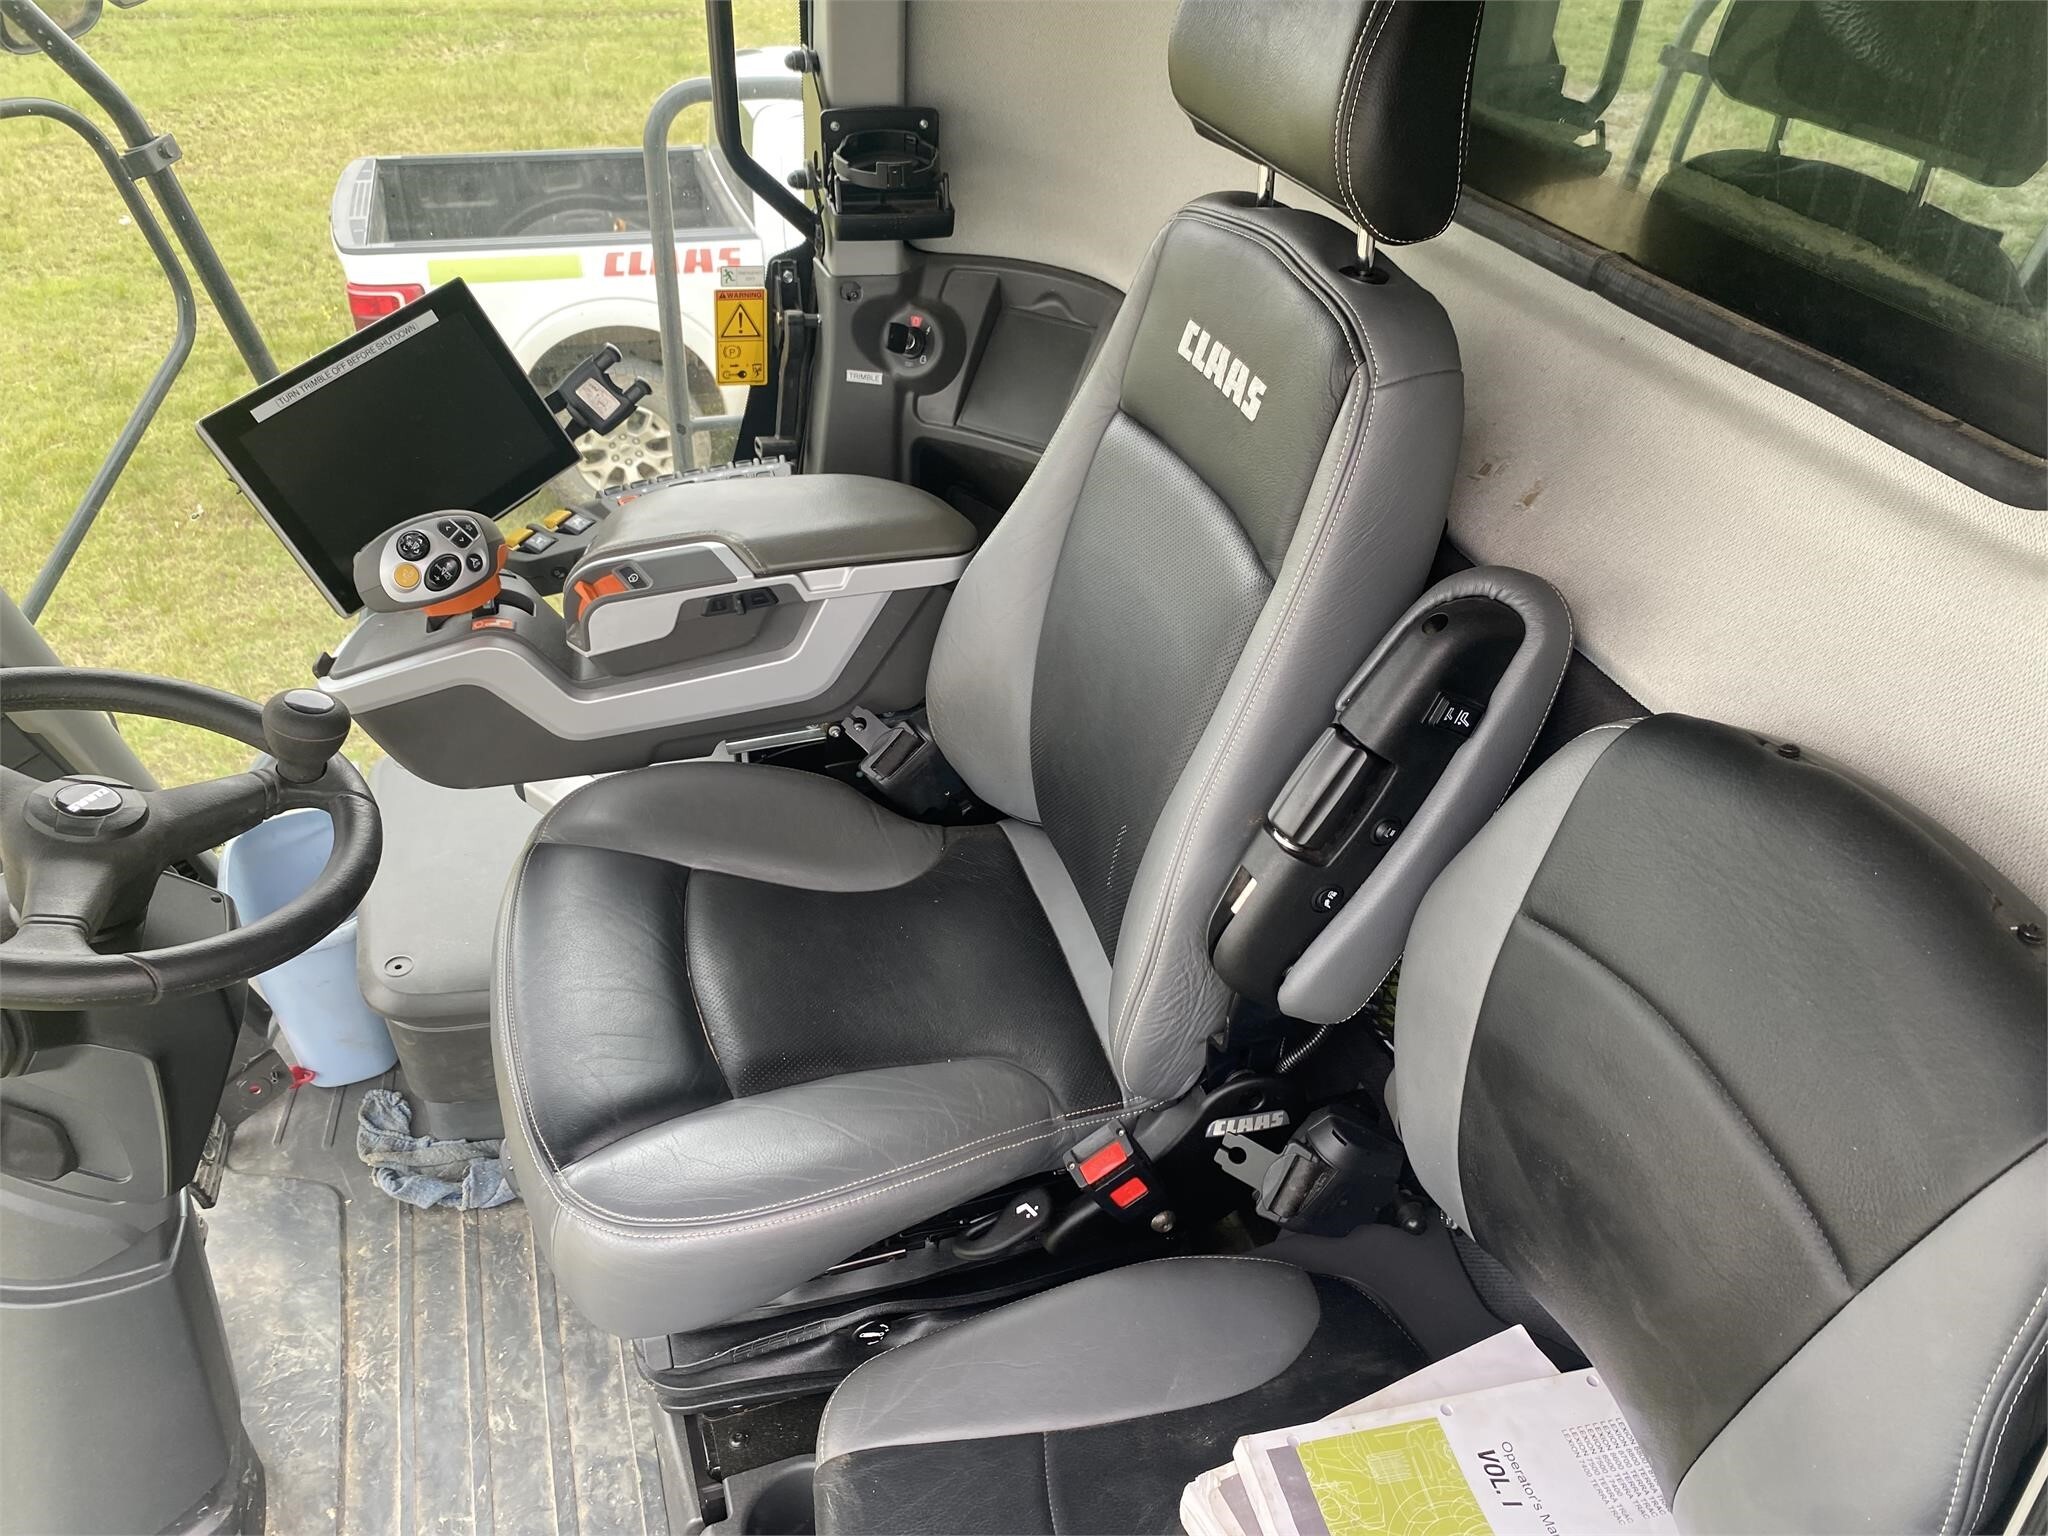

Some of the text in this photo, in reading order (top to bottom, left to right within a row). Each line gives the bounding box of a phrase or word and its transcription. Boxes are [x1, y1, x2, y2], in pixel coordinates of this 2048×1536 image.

[278, 324, 418, 406] TURN TRIMBLE OFF BEFORE SHUTDOWN
[849, 372, 880, 382] TRIMBLE
[1177, 319, 1268, 422] CLAAS
[1212, 1111, 1284, 1136] CLAAS
[1576, 1425, 1597, 1455] LEXION
[1592, 1422, 1613, 1451] LEXION
[1622, 1471, 1642, 1497] TERRA
[1640, 1498, 1659, 1518] TRAC
[1600, 1420, 1621, 1449] LEXION
[1630, 1469, 1650, 1495] TERRA
[1648, 1497, 1667, 1515] TRAC
[1607, 1419, 1628, 1448] LEXION
[1638, 1467, 1658, 1494] TERRA
[1615, 1417, 1636, 1445] LEXION
[1477, 1449, 1510, 1495] VOL.
[1501, 1441, 1543, 1511] Operator's
[1561, 1428, 1581, 1458] LEXION
[1591, 1479, 1610, 1505] TERRA
[1609, 1505, 1626, 1526] TRAC
[1568, 1427, 1589, 1456] LEXION
[1599, 1477, 1618, 1503] TERRA
[1617, 1504, 1634, 1524] TRAC
[1585, 1424, 1605, 1453] LEXION
[1614, 1473, 1634, 1499] TERRA
[1632, 1500, 1650, 1520] TRAC
